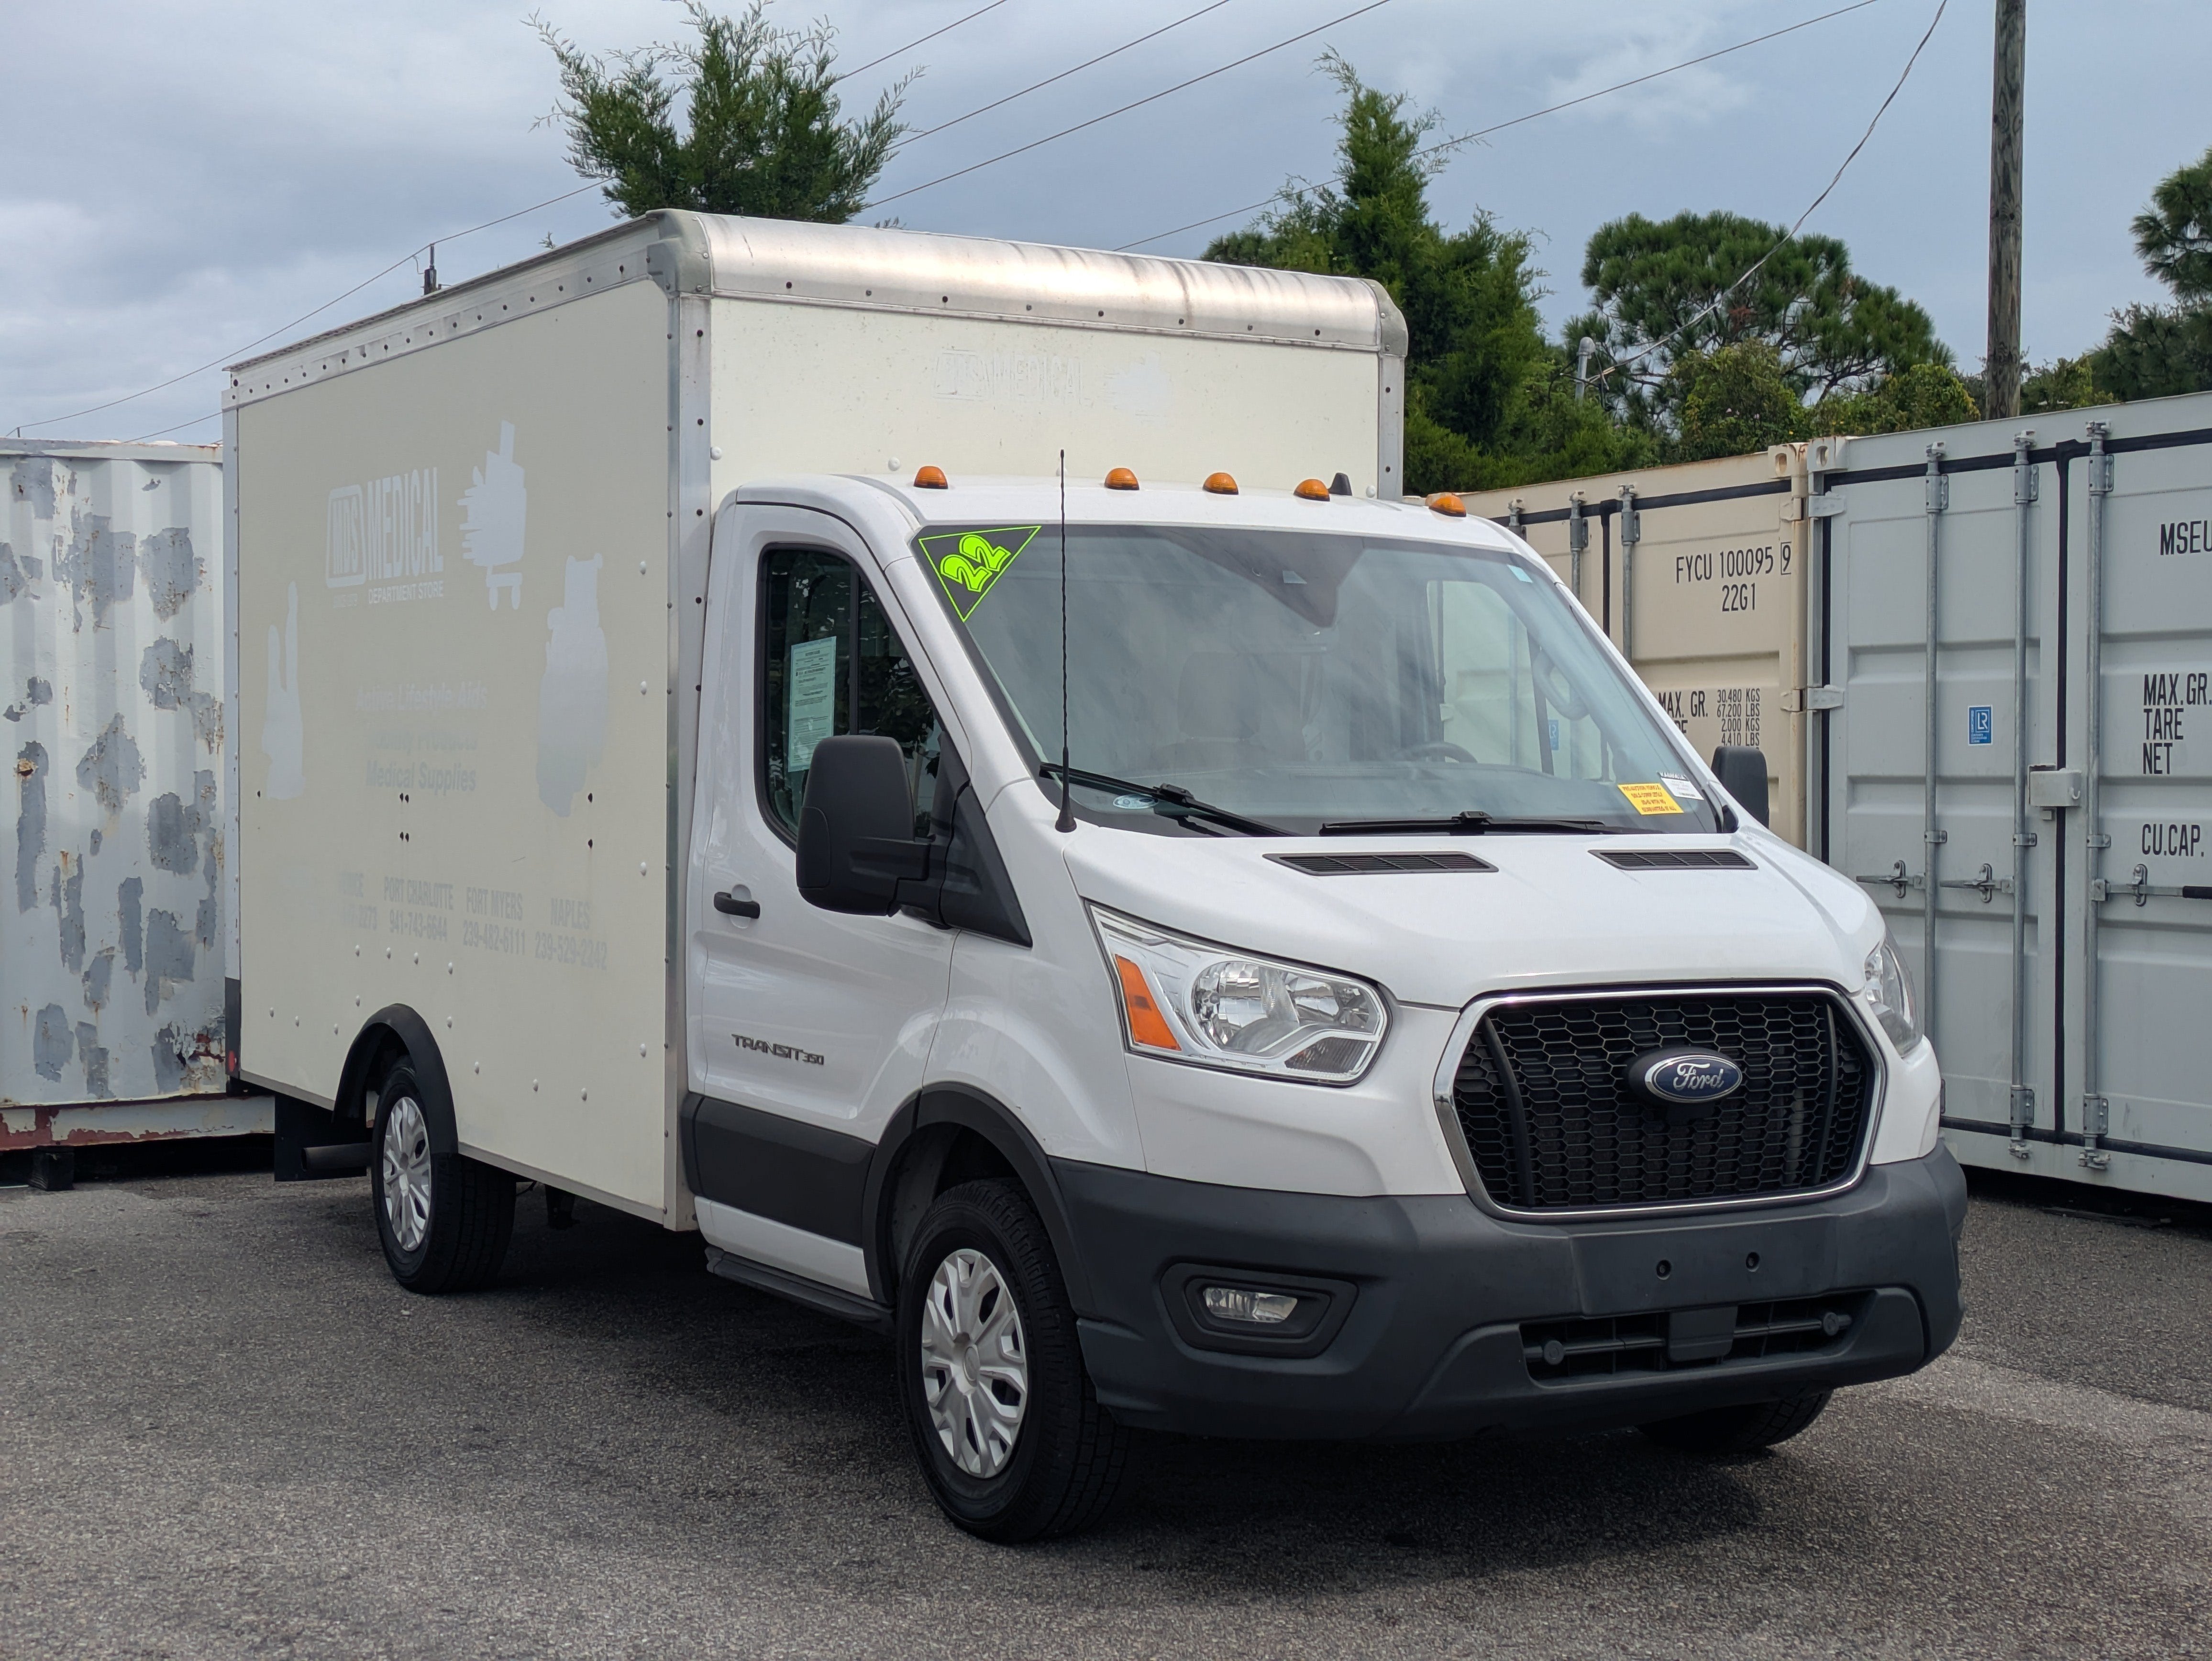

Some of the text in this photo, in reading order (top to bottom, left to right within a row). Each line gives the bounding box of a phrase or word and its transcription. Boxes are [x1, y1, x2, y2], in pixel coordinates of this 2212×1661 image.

[367, 466, 443, 581] MEDICAL
[2160, 520, 2212, 555] MSEU
[940, 534, 1011, 592] 22
[1676, 544, 1791, 584] FYCU 100095 9
[368, 583, 417, 605] DEPARTMENT
[418, 580, 444, 599] STORE
[1722, 582, 1756, 612] 22G1
[1691, 690, 1708, 717] GR.
[1717, 688, 1760, 703] 30.480 KGS
[1717, 703, 1760, 718] 67.200 LBS
[1721, 718, 1760, 732] 2.000 KGS
[1978, 712, 1988, 730] LR
[2143, 708, 2184, 740] TARE
[1721, 732, 1760, 746] 4.410 LBS
[2143, 742, 2173, 775] NET
[366, 759, 476, 796] Medical Supplies
[2142, 823, 2205, 857] CU.CAP.
[383, 875, 454, 910] PORT CHARLOTTE
[466, 886, 524, 921] FORT MYERS
[551, 897, 591, 930] NAPLES
[731, 1033, 804, 1061] TRANSIT
[1673, 1063, 1725, 1091] Ford
